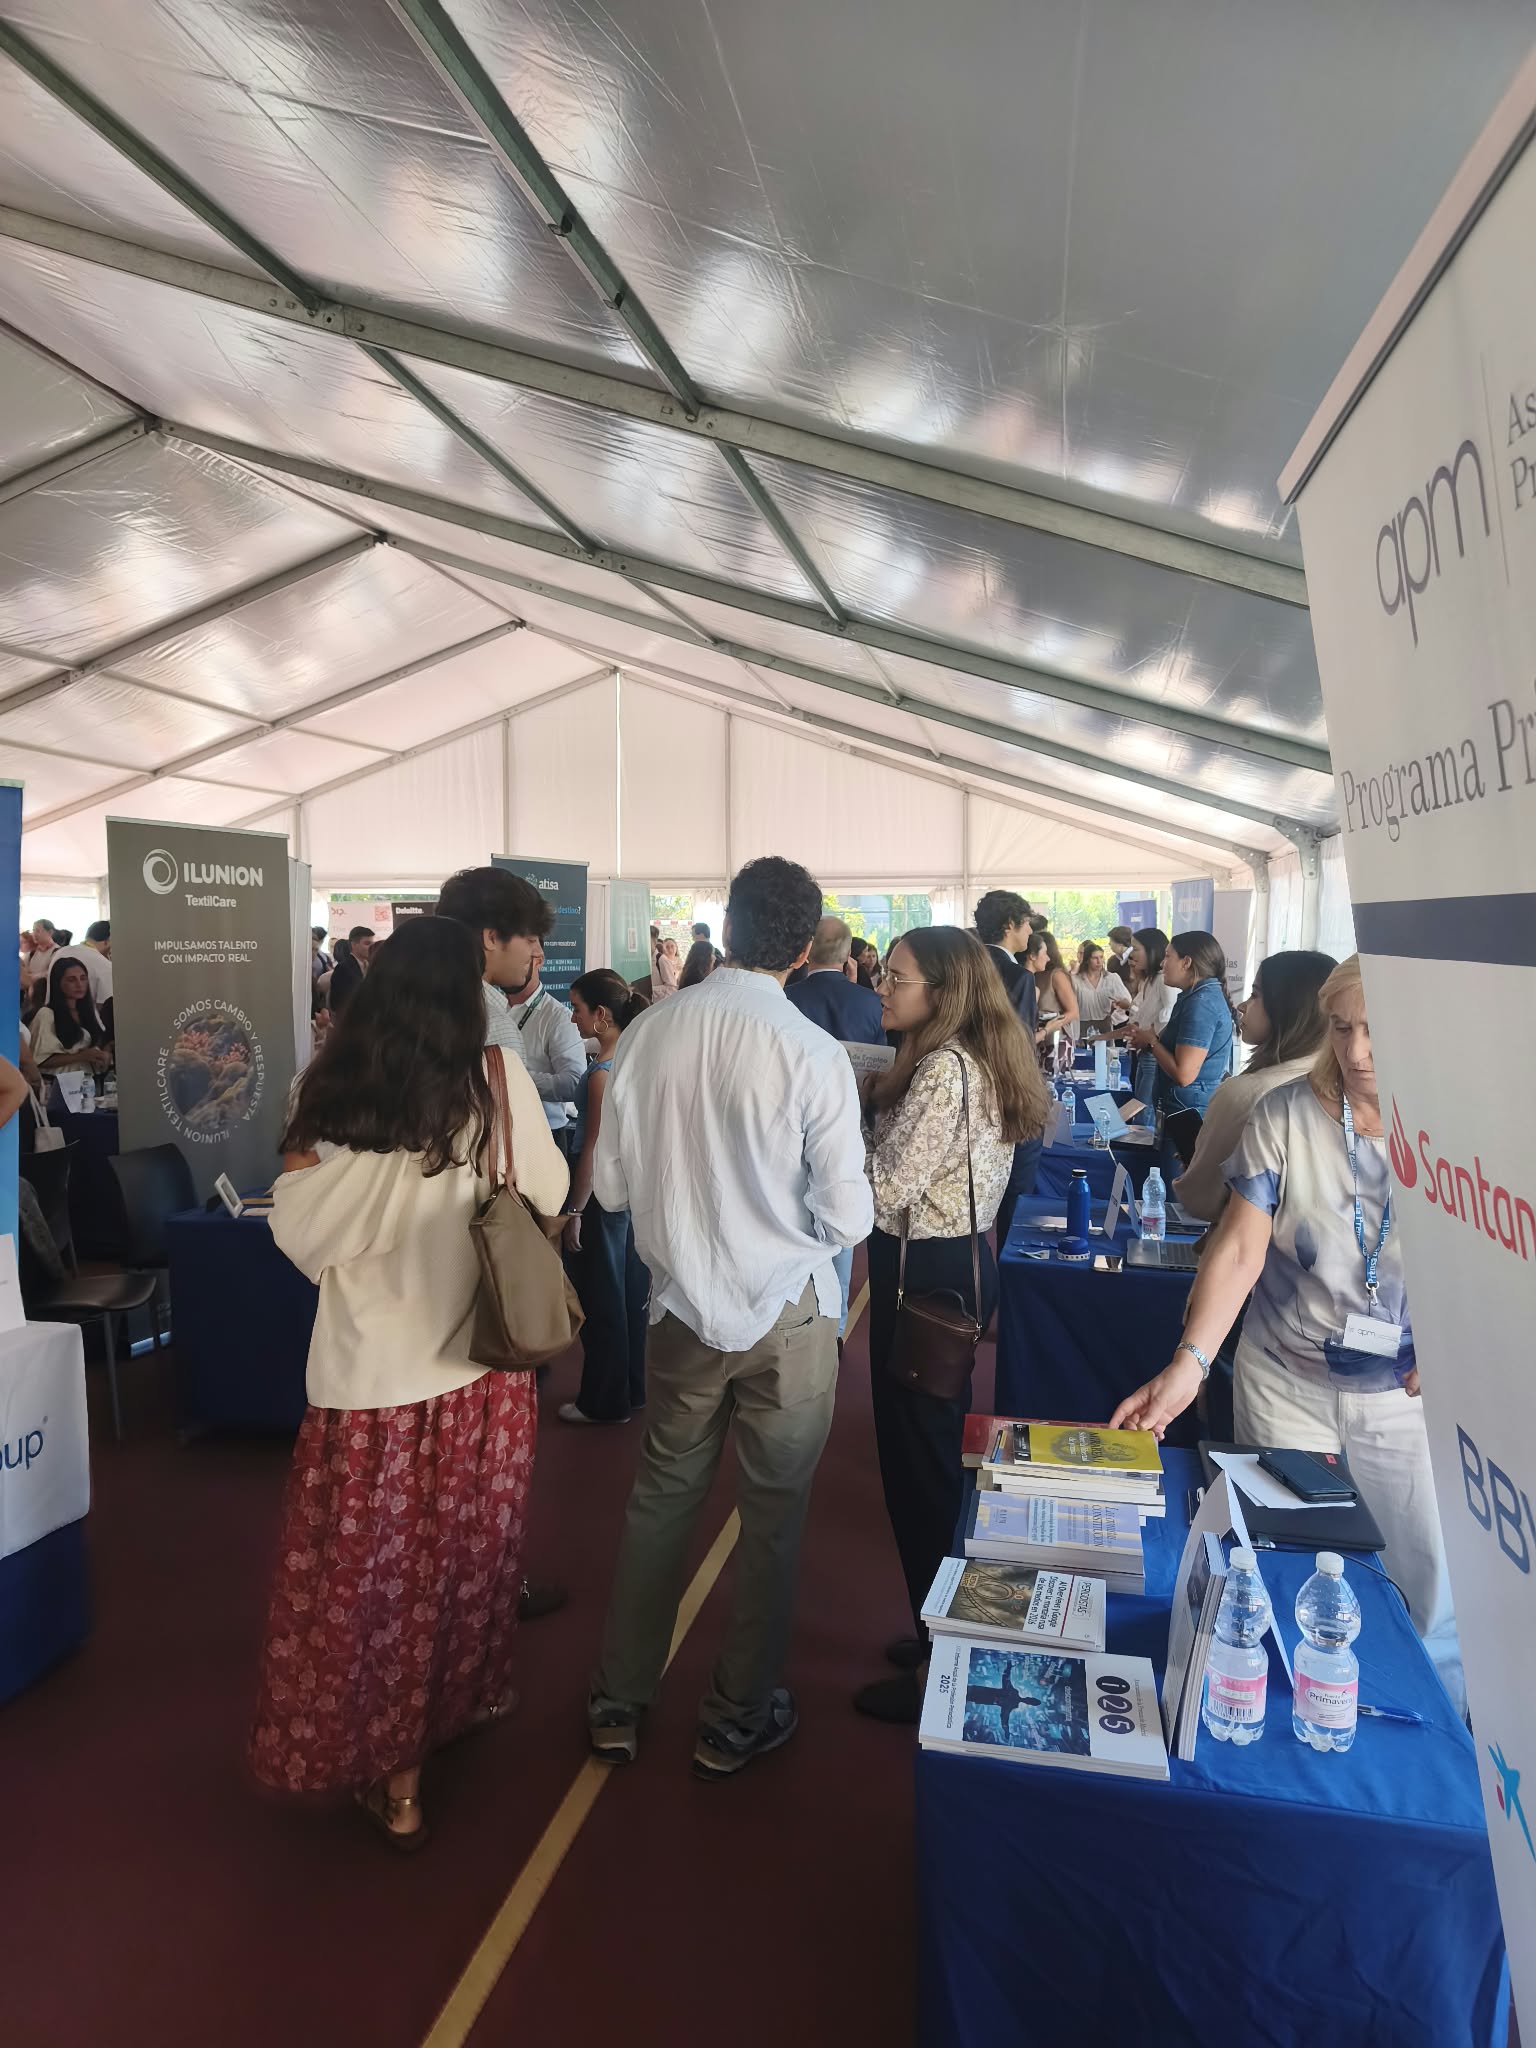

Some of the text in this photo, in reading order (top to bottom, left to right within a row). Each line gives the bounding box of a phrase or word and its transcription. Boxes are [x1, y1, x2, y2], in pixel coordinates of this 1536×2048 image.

[1376, 439, 1490, 649] apm
[1341, 737, 1486, 843] Programa
[183, 862, 263, 887] ILUNION
[538, 878, 559, 890] atisa
[185, 894, 237, 908] TextilCare
[395, 907, 424, 915] Deloitte.
[154, 940, 258, 951] IMPULSAMOS TALENTO
[162, 953, 182, 964] CON
[185, 953, 226, 963] IMPACTO
[173, 999, 265, 1121] SOMOS CAMBIO Y RESPUESTA
[156, 1047, 230, 1144] ILUNION TEXTILCARE
[1368, 1257, 1378, 1284] Prensa
[0, 1429, 44, 1472] up
[1077, 1582, 1092, 1614] PERIODISTAS
[1048, 1611, 1061, 1628] Google
[939, 1674, 951, 1694] 2025
[1309, 1691, 1353, 1705] Primavera
